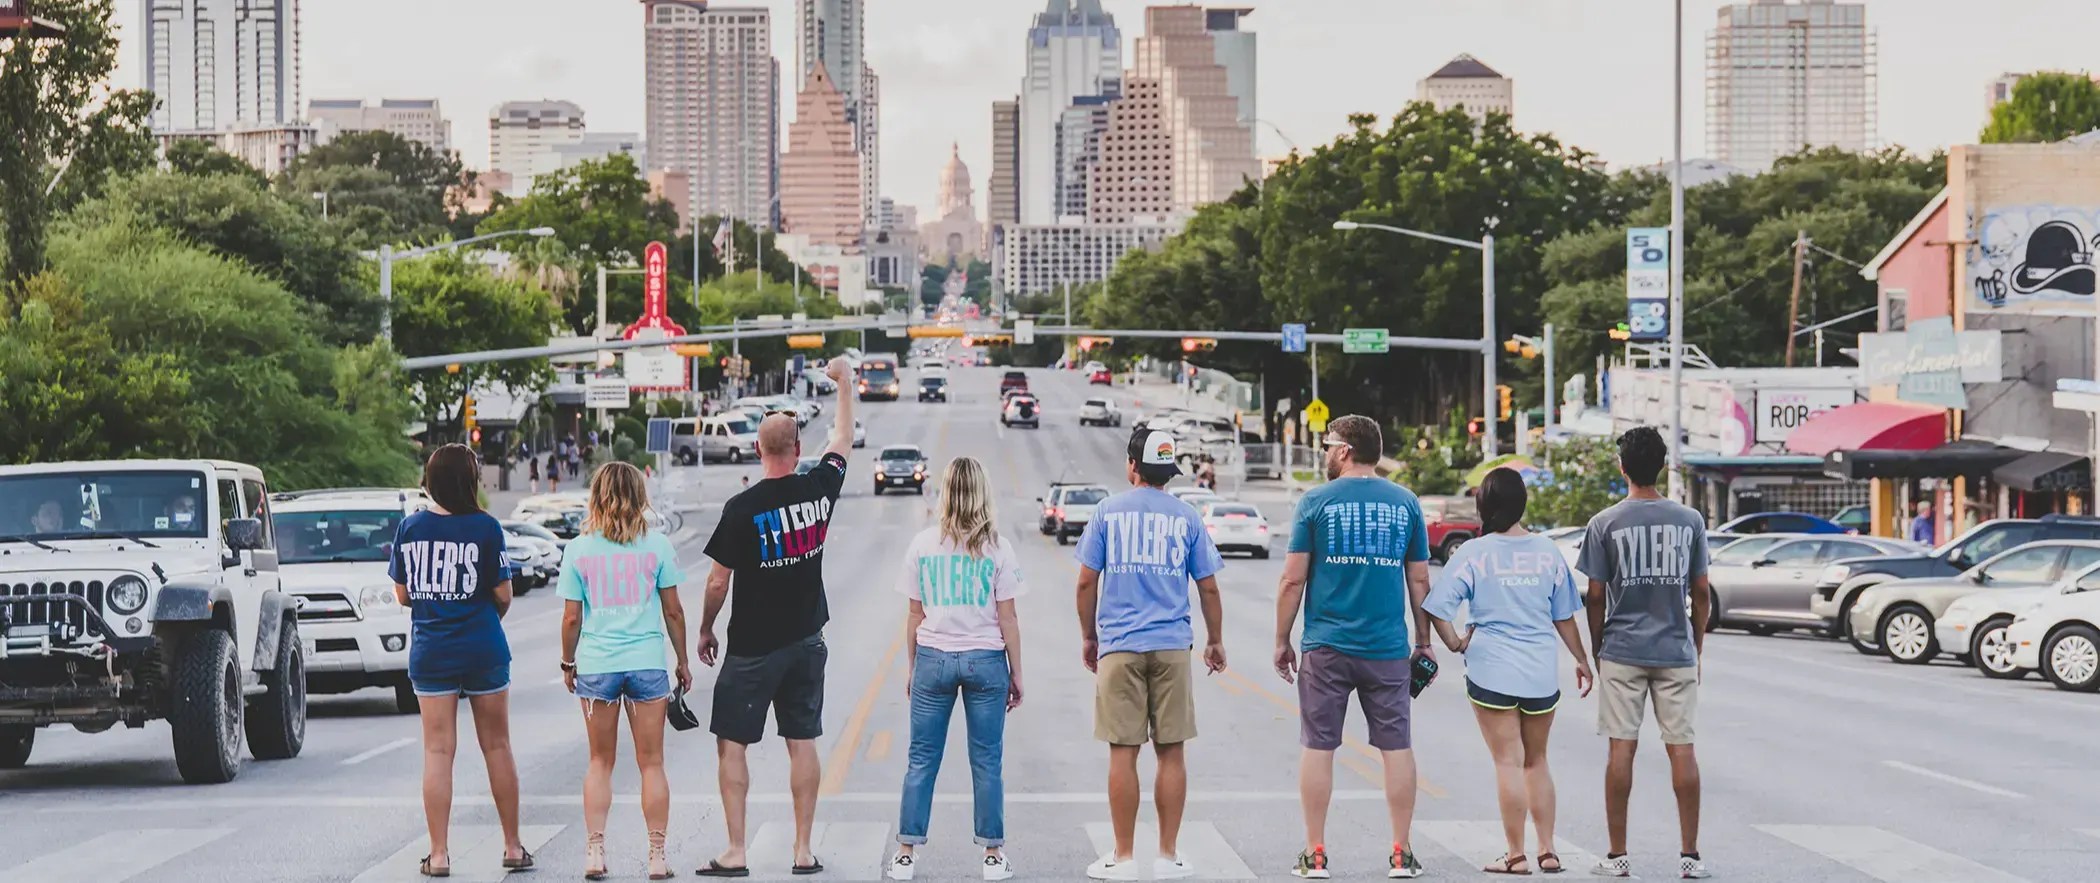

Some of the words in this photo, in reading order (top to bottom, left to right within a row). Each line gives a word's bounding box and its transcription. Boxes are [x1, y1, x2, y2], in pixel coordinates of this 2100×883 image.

[650, 251, 661, 328] AUSTIN
[1771, 404, 1840, 428] ROB
[805, 544, 824, 559] TEXA
[1104, 511, 1187, 568] TYLER'S
[1324, 502, 1409, 555] TYLER'S
[1611, 524, 1694, 578] TYLER'S
[401, 541, 479, 593] TYLER'S
[575, 552, 657, 608] TYLER'S
[919, 554, 994, 607] TYLER'S
[1107, 564, 1148, 575] AUSTIN,
[1152, 566, 1182, 577] TEXAS
[1326, 556, 1370, 565] AUSTIN,
[1374, 557, 1401, 567] TEXAS
[1500, 576, 1540, 586] TEXAS
[1659, 577, 1686, 586] TEXS
